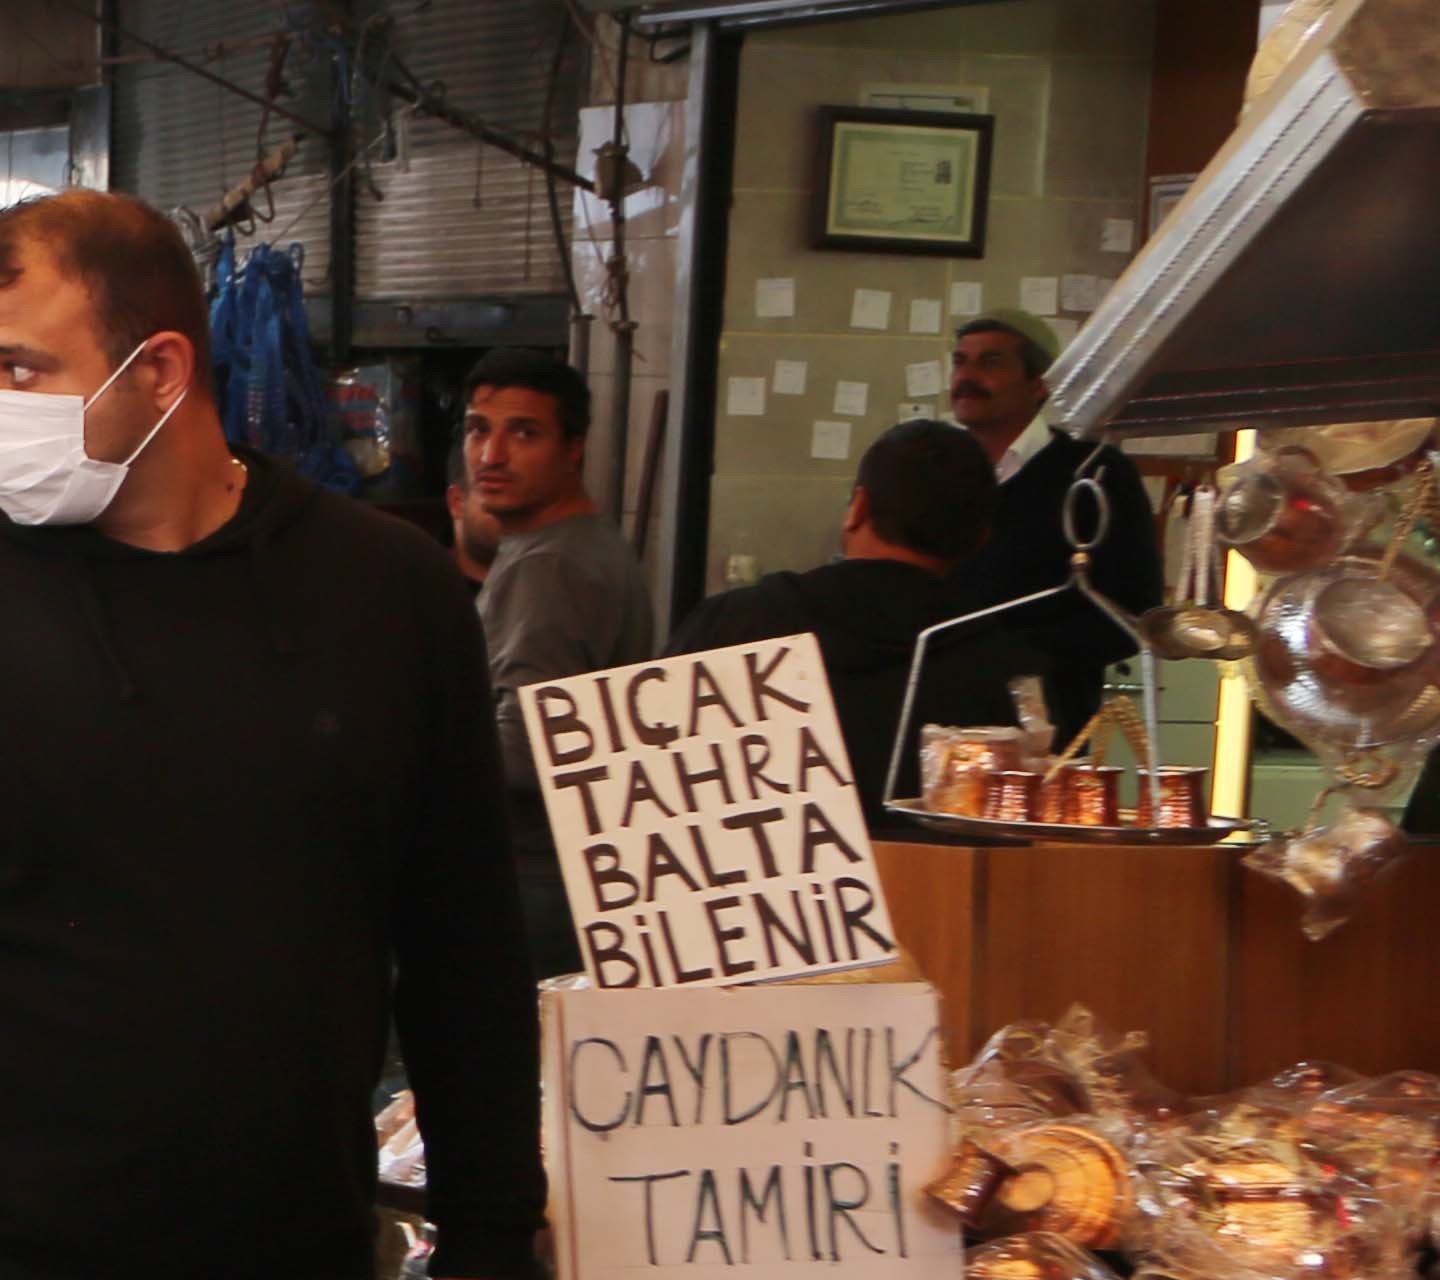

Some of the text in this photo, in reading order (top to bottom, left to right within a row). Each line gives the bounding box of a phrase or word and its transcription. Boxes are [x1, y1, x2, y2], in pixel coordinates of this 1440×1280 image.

[535, 646, 811, 767] BIÇAK
[553, 726, 855, 837] TAHRA
[583, 801, 863, 913] BALTA
[607, 1141, 908, 1267] TAMİRİ
